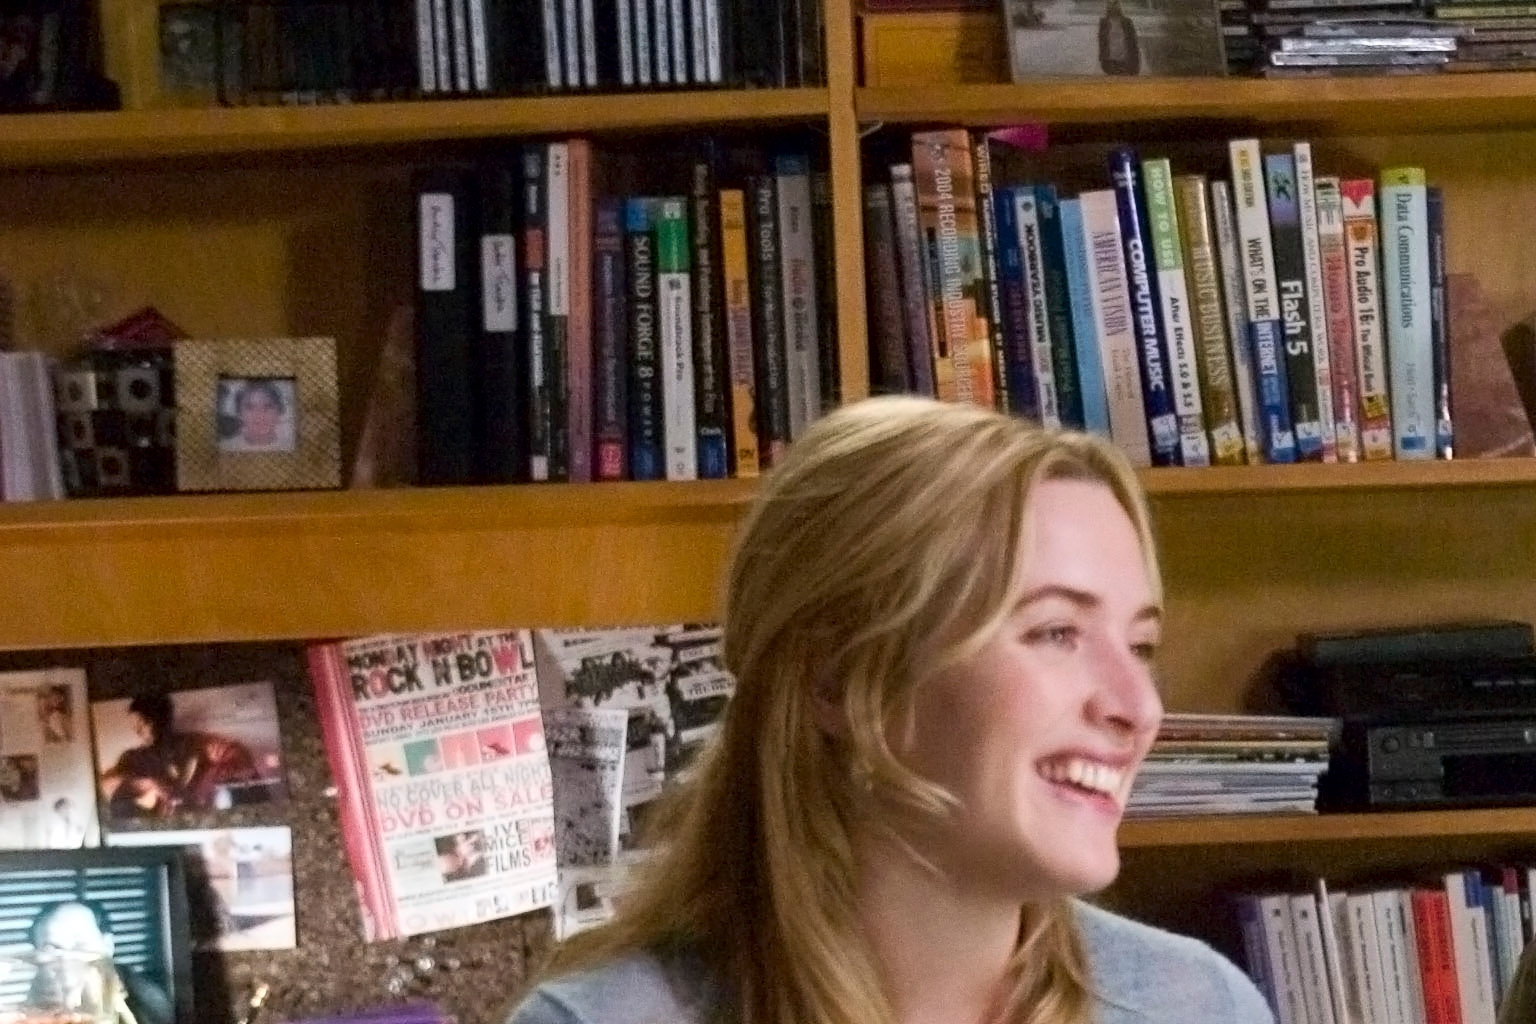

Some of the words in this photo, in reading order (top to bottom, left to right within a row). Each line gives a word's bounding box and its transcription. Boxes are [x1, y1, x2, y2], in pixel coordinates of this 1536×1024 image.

[756, 188, 773, 214] Pro
[1149, 166, 1166, 205] HOW
[1156, 211, 1170, 234] TO
[1395, 193, 1413, 222] Data
[758, 221, 775, 260] Tools
[1160, 238, 1175, 268] USE
[1246, 237, 1265, 274] WHAT'S
[1353, 245, 1370, 267] Pro
[633, 236, 652, 297] SOUND
[1024, 224, 1042, 297] YEARBOOK
[1396, 225, 1418, 329] Communications
[1251, 276, 1268, 295] ON
[1355, 269, 1372, 303] Audio
[1032, 299, 1047, 343] MUSIC
[1128, 237, 1156, 336] COMPUTER
[1142, 337, 1164, 392] MUSIC
[1168, 295, 1181, 322] After
[1254, 296, 1271, 321] THE
[1281, 277, 1306, 335] Flash
[1358, 307, 1374, 326] 16:
[636, 303, 655, 361] FORGE
[672, 295, 685, 358] Soundtrack
[1172, 326, 1186, 360] Effects
[1361, 328, 1371, 342] The
[1255, 320, 1278, 376] INTERNET
[1287, 340, 1308, 356] 5
[637, 365, 656, 379] 8
[675, 362, 686, 381] Pro
[351, 662, 424, 701] ROCK
[456, 641, 535, 682] BOWL
[361, 707, 397, 729] DVD
[400, 693, 482, 723] RELEASE
[485, 682, 538, 706] PARTY
[364, 723, 414, 737] SUNDAY
[418, 711, 478, 730] JANUARY
[406, 774, 464, 807] COVER
[469, 768, 497, 798] ALL
[381, 804, 436, 833] DVD
[445, 796, 485, 821] ON
[493, 784, 553, 810] SALE
